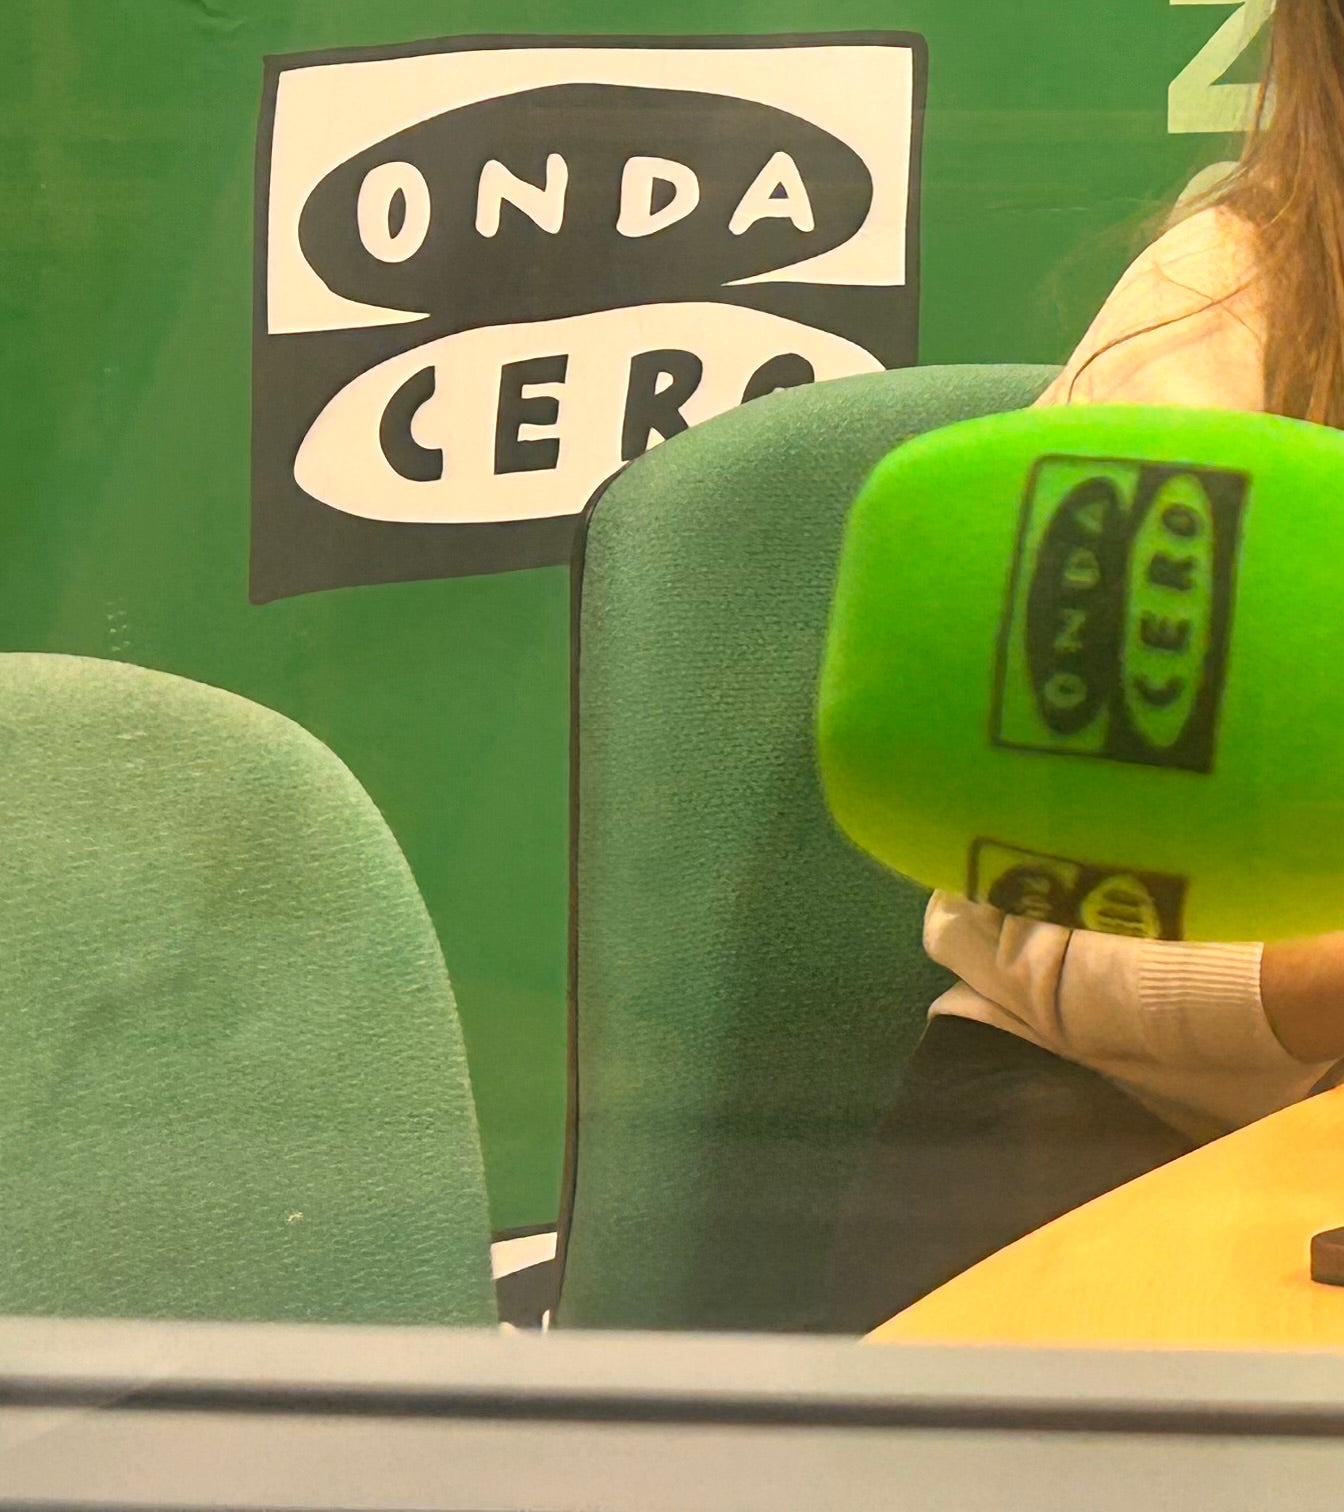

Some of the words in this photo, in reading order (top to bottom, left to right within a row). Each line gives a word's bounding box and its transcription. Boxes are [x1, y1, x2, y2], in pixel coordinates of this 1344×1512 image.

[356, 150, 815, 263] ONDA
[1043, 500, 1107, 709] ONDA
[1131, 501, 1202, 708] CERO
